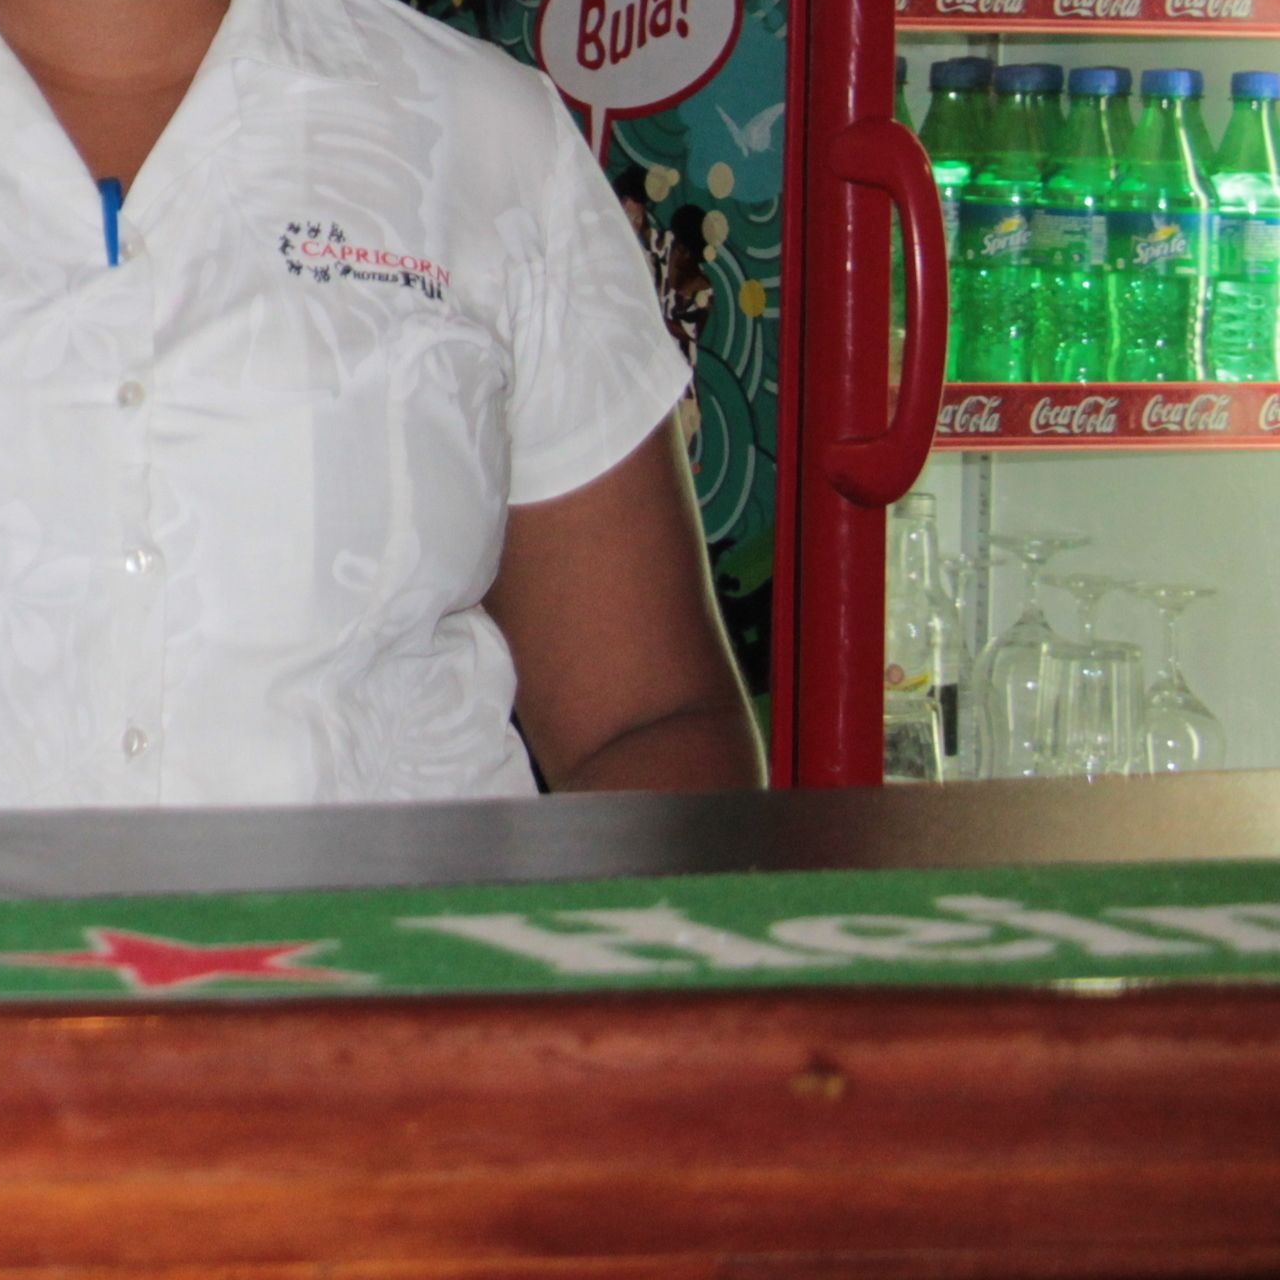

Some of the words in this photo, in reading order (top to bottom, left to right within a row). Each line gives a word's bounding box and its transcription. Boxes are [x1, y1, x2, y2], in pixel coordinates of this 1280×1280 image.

[981, 228, 1033, 256] Sprite
[1132, 237, 1187, 265] Sprite
[300, 239, 452, 288] CAPRICORN
[1030, 396, 1120, 434] Coca-Cola
[1143, 393, 1232, 433] Coca-Cola
